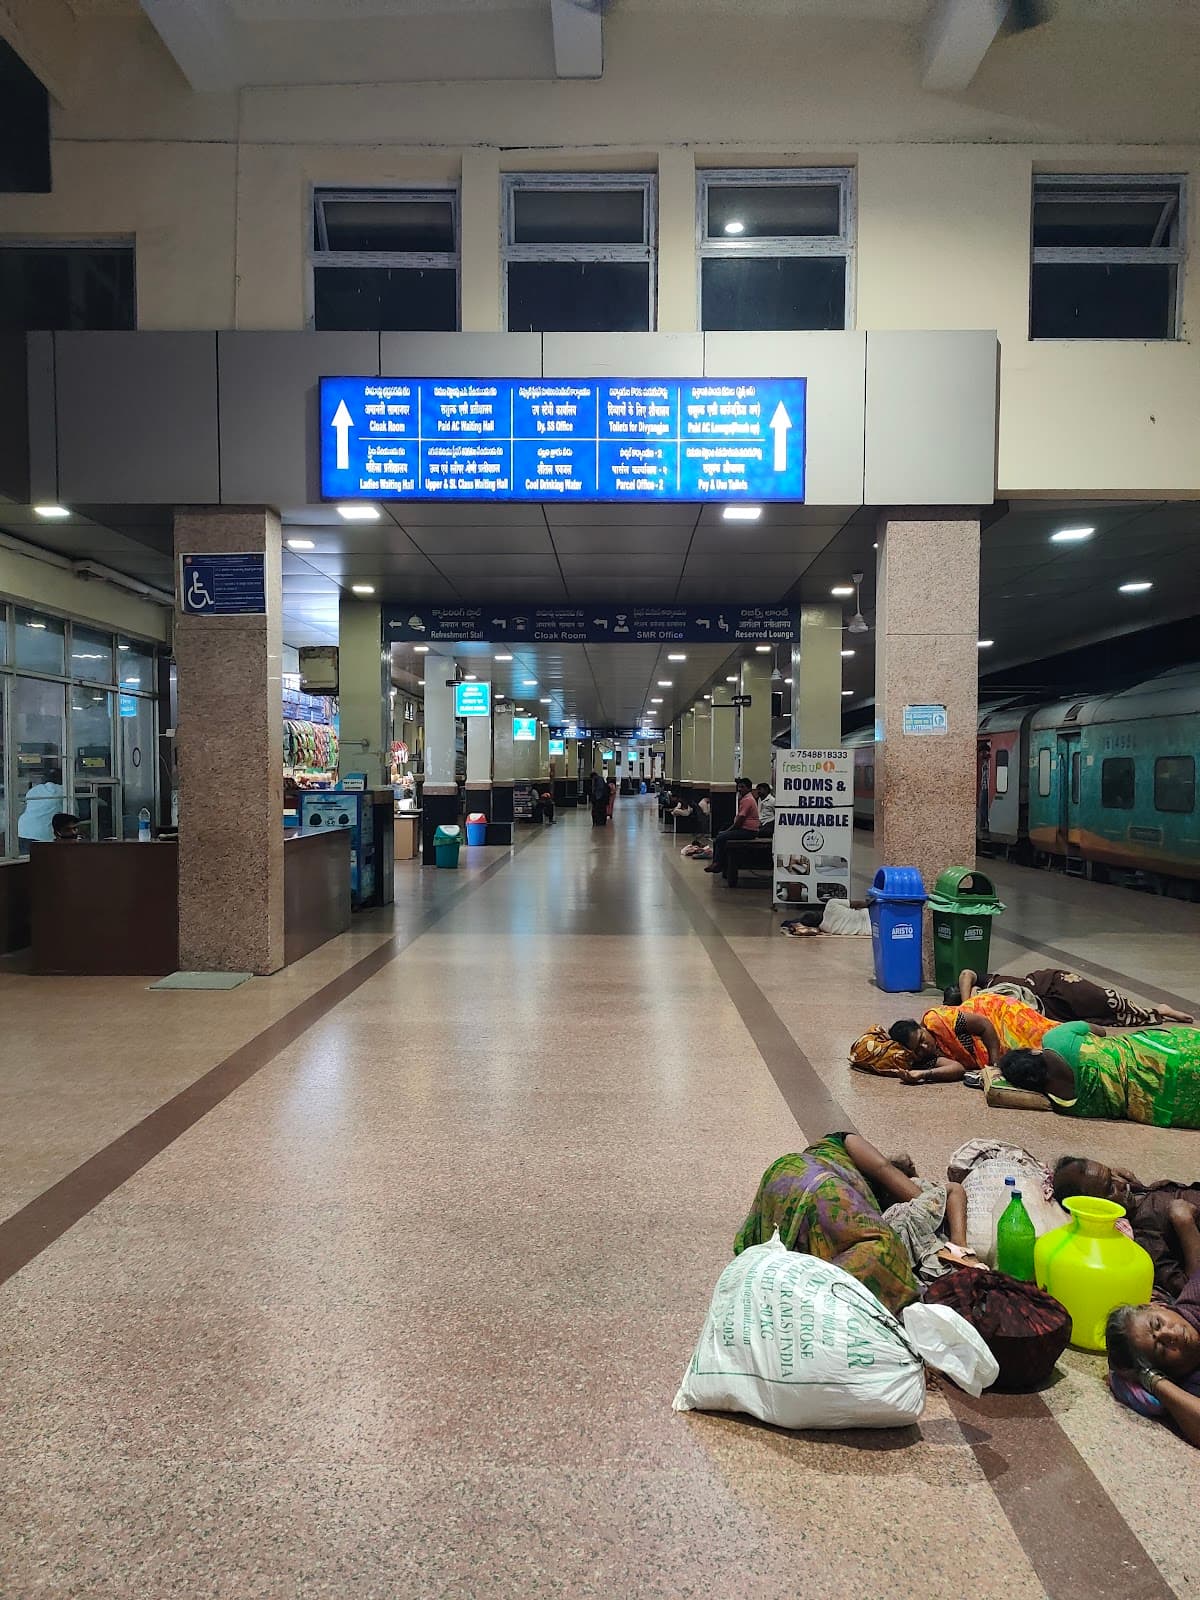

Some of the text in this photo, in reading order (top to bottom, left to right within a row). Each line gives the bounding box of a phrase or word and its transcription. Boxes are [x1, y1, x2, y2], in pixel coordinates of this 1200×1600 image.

[628, 402, 634, 416] के
[370, 420, 405, 432] Cloak Room
[438, 420, 494, 433] Paid AC Waiting Hall
[547, 421, 554, 431] SS
[556, 420, 573, 431] Office
[609, 421, 628, 432] Toilets
[629, 422, 637, 432] for
[702, 422, 711, 433] AC
[360, 479, 414, 492] Ladies Waiting Hall
[425, 478, 442, 491] Upper
[475, 479, 495, 491] Waiting
[496, 479, 508, 489] Hall
[525, 479, 582, 492] Cool Drinking Water
[616, 479, 635, 490] Parcel
[637, 479, 654, 490] Office
[659, 479, 663, 490] 2
[698, 479, 709, 492] Pay
[728, 479, 748, 490] Toilets
[431, 631, 484, 639] Refreshment Stall
[659, 631, 683, 639] Office
[769, 631, 794, 639] Lounge
[783, 762, 807, 772] fresh
[784, 778, 846, 791] ROOMS &
[799, 796, 833, 808] BEDS
[779, 813, 848, 827] AVAILABLE
[759, 1303, 773, 1317] 50
[722, 1296, 736, 1348] 23-2024
[799, 1297, 815, 1360] SUCROSE
[760, 1319, 775, 1341] KG
[779, 1337, 794, 1379] INDIA
